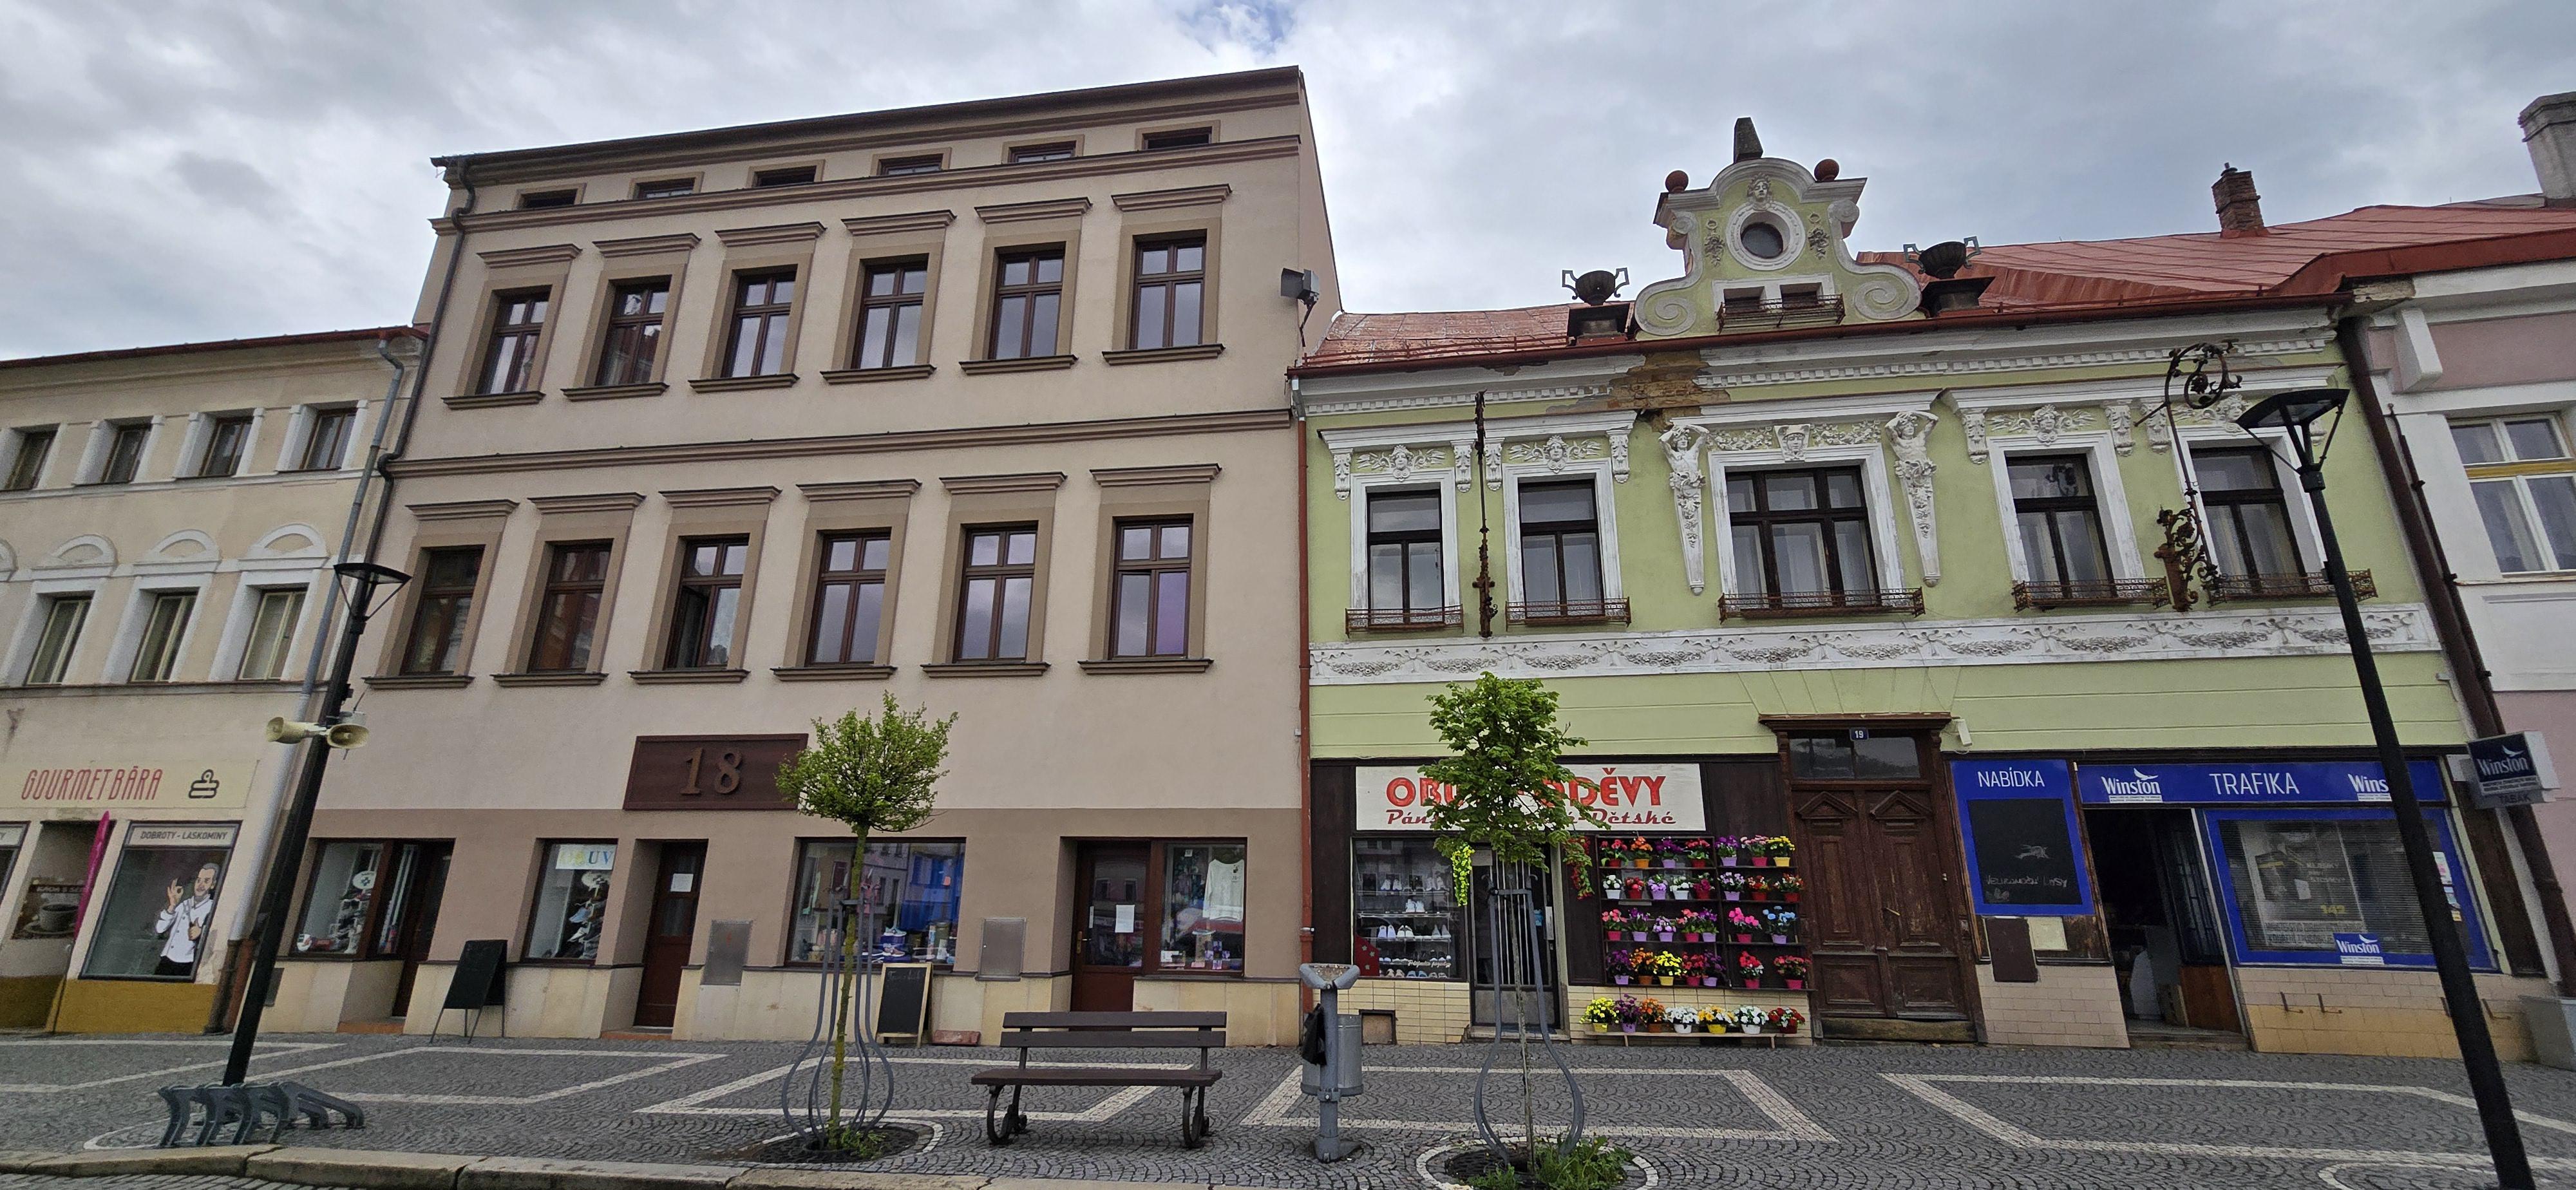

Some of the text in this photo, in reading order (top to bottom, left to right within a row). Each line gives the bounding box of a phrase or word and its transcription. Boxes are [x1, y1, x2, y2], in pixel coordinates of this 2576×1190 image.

[1855, 730, 1864, 739] 19
[679, 747, 742, 795] 18
[2477, 757, 2530, 776] Winston
[21, 769, 113, 800] GOURMET
[1978, 767, 2045, 788] NABÍDKA
[2101, 776, 2161, 794] Winston
[2209, 772, 2300, 795] TRAFIKA
[2347, 773, 2389, 793] Wins
[140, 831, 177, 840] DOBROTY
[182, 831, 228, 840] LASKOMINY
[2336, 940, 2380, 954] Winston
